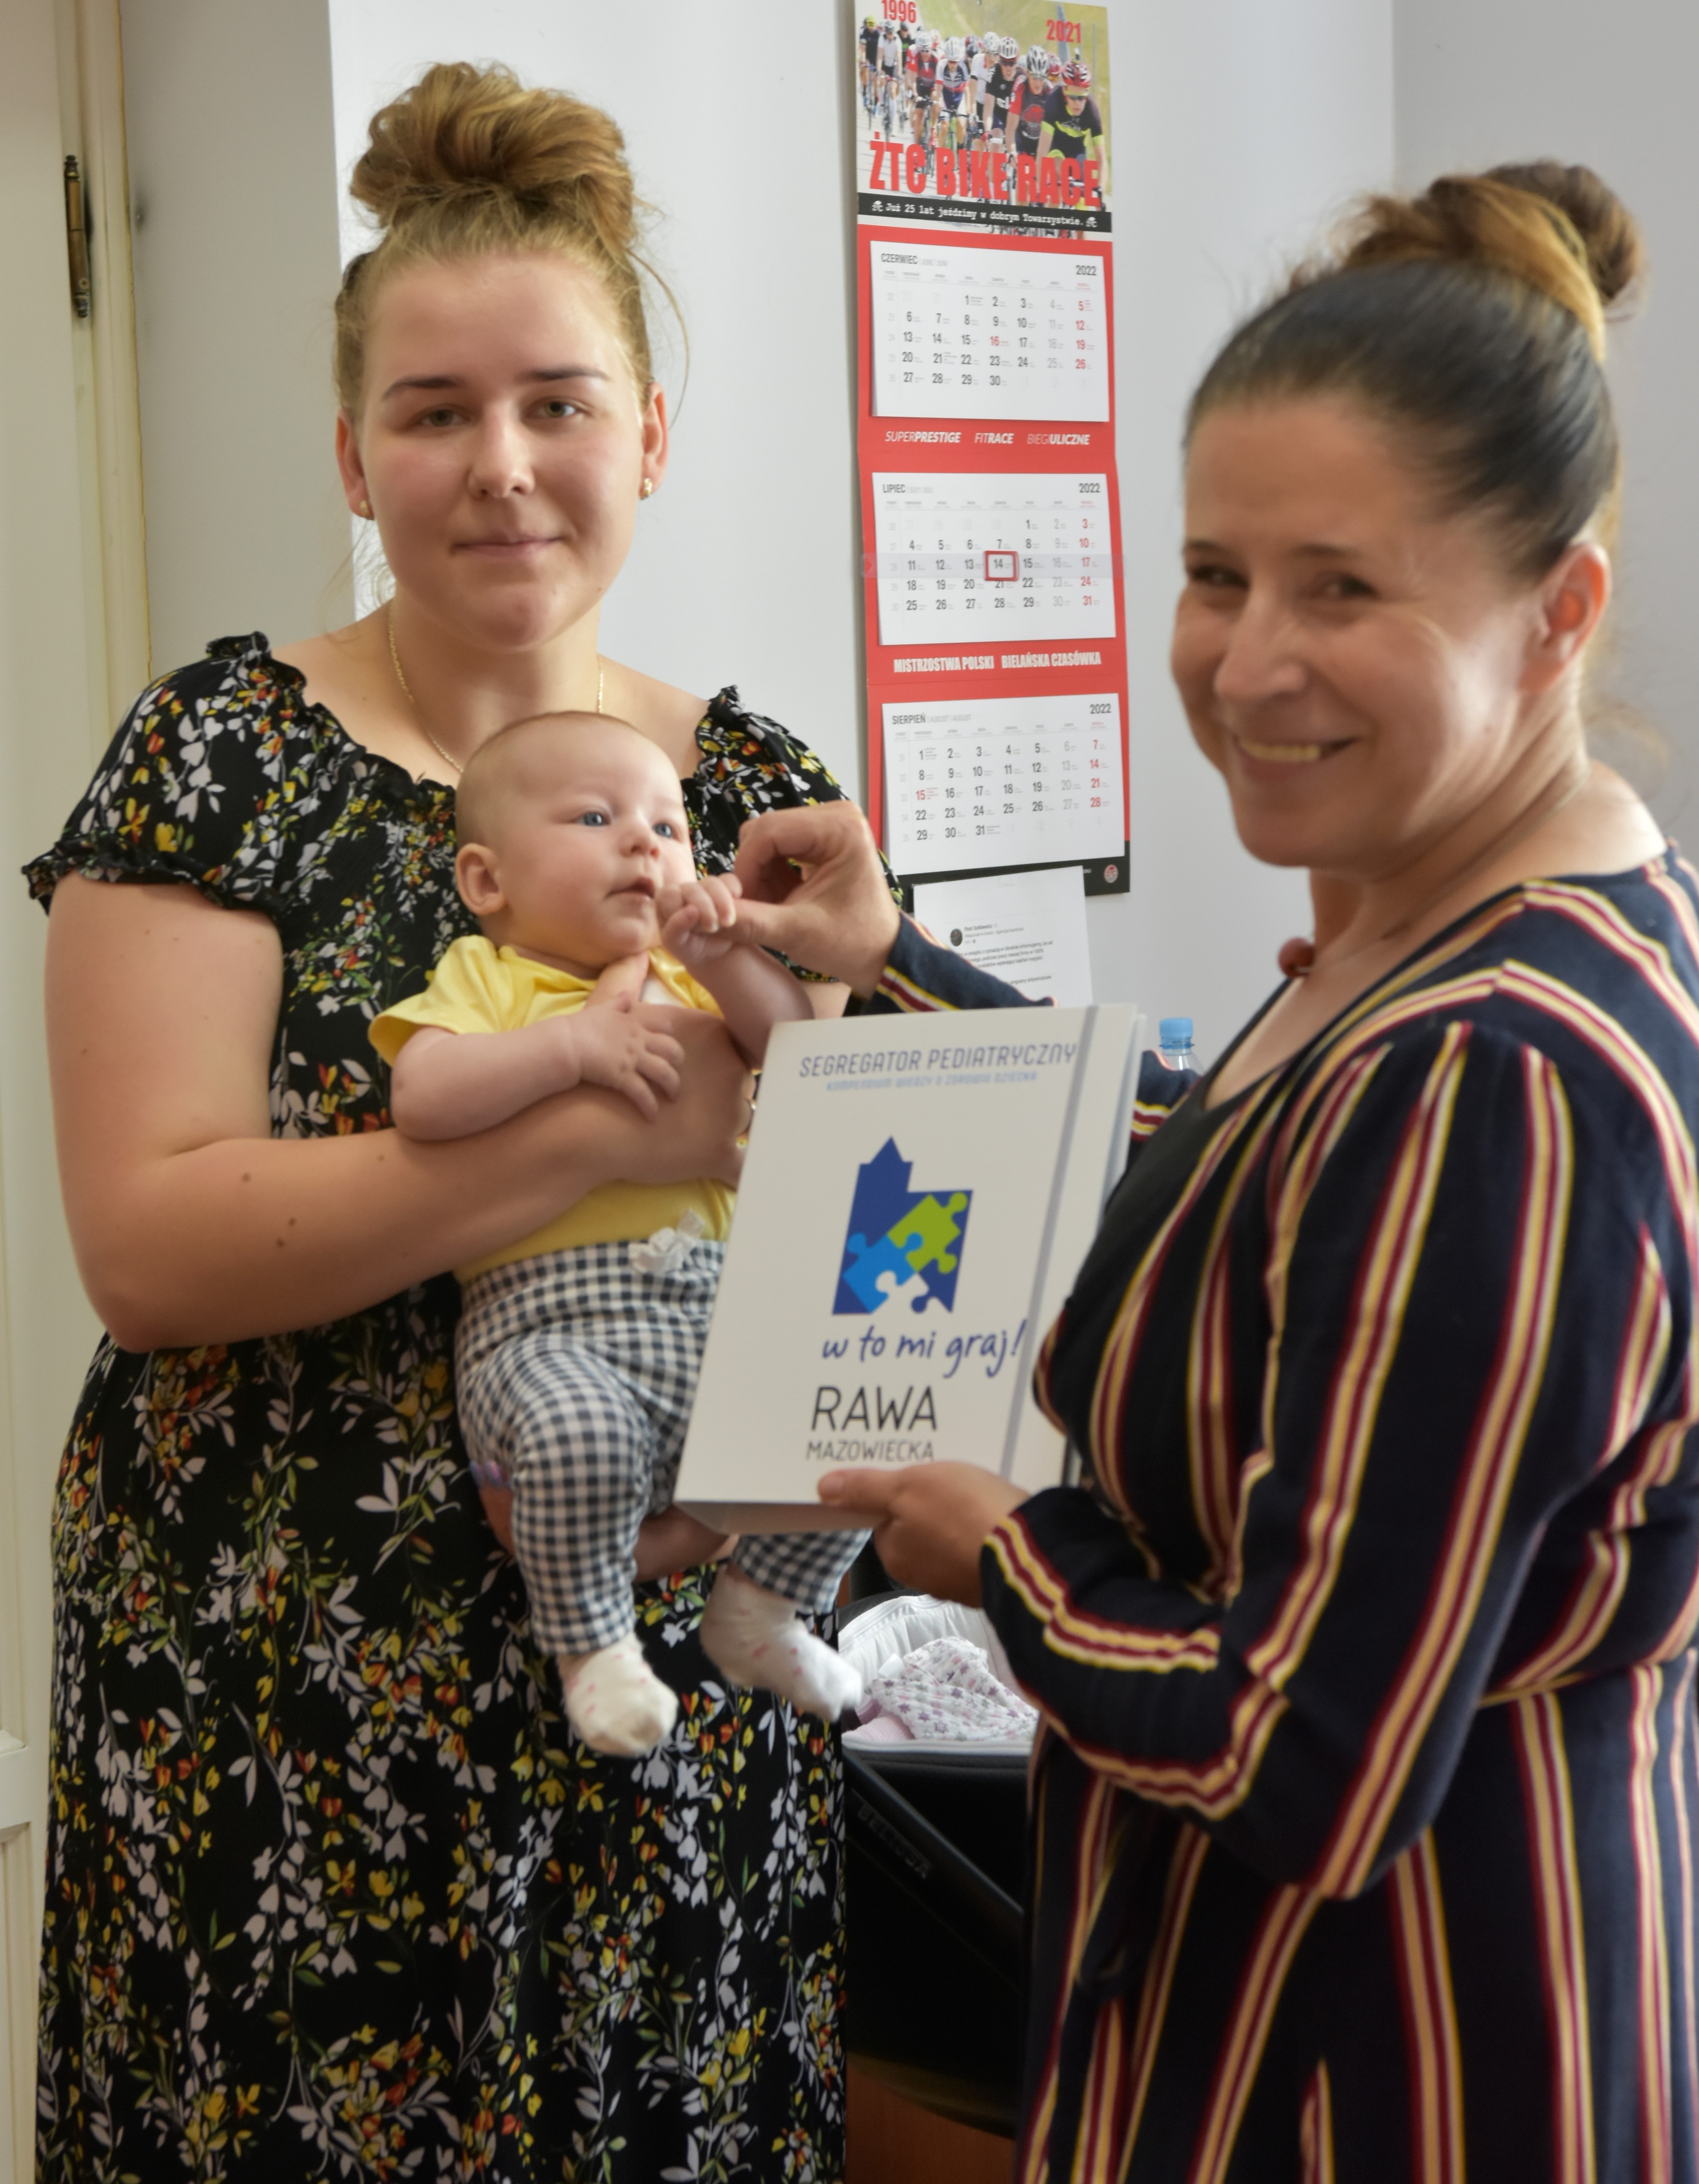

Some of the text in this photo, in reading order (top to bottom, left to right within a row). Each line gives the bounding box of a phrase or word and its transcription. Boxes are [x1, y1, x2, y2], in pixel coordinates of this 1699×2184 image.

[882, 0, 916, 23] 1996
[1046, 19, 1081, 43] 2021
[870, 131, 1101, 207] ŻTC BIKE RACE
[886, 203, 901, 212] Już
[905, 204, 915, 213] 25
[919, 205, 934, 214] lat
[990, 211, 1020, 222] dobrym
[1023, 214, 1083, 225] Towarzystwie.
[881, 253, 918, 265] CZERWIEC
[1076, 265, 1097, 276] 2022
[965, 295, 969, 305] 1
[993, 296, 998, 306] 2
[1021, 298, 1026, 308] 3
[1079, 301, 1084, 311] 5
[907, 311, 912, 322] 6
[936, 313, 941, 323] 7
[965, 314, 970, 325] 8
[993, 316, 998, 326] 9
[1017, 318, 1027, 328] 10
[1076, 320, 1084, 330] 12
[903, 332, 912, 342] 13
[933, 333, 942, 343] 14
[962, 335, 970, 345] 15
[990, 336, 999, 346] 16
[1019, 337, 1027, 347] 17
[1076, 340, 1085, 350] 19
[903, 352, 913, 362] 20
[934, 353, 942, 363] 21
[961, 355, 971, 364] 22
[990, 355, 1000, 366] 23
[1018, 357, 1028, 367] 24
[1076, 359, 1086, 369] 26
[904, 372, 913, 382] 27
[933, 373, 943, 384] 28
[962, 374, 972, 384] 29
[990, 376, 1000, 385] 30
[885, 431, 961, 443] SUPERPRESTIGE
[975, 433, 1014, 444] FITRACE
[882, 484, 906, 493] LIPIEC
[1079, 483, 1101, 494] 2022
[1026, 519, 1030, 529] 1
[1082, 518, 1088, 528] 3
[910, 540, 915, 550] 4
[939, 540, 943, 550] 5
[968, 539, 972, 549] 6
[997, 539, 1002, 550] 7
[1026, 539, 1031, 548] 8
[1079, 538, 1089, 548] 10
[908, 560, 915, 570] 11
[936, 559, 945, 570] 12
[965, 559, 974, 569] 13
[994, 559, 1003, 568] 14
[1023, 558, 1033, 568] 15
[1082, 557, 1090, 567] 17
[907, 580, 916, 590] 18
[936, 580, 945, 590] 19
[964, 579, 975, 589] 20
[995, 580, 1005, 589] 21
[1023, 577, 1033, 588] 22
[1081, 576, 1091, 586] 24
[907, 600, 917, 610] 25
[936, 600, 947, 609] 26
[966, 599, 976, 608] 27
[995, 598, 1005, 608] 28
[1024, 597, 1034, 607] 29
[1083, 596, 1091, 605] 31
[894, 650, 1102, 673] MISTRZOSTWA POLSKI BIELAŃSKA CZASÓWKA
[892, 712, 926, 725] SIERPIEŃ
[1090, 703, 1111, 715] 2022
[919, 750, 923, 760] 1
[948, 748, 953, 758] 2
[977, 747, 982, 756] 3
[1006, 745, 1011, 754] 4
[1035, 743, 1040, 753] 5
[1093, 739, 1098, 749] 7
[919, 770, 925, 780] 8
[949, 768, 954, 778] 9
[973, 766, 982, 776] 10
[1005, 764, 1012, 774] 11
[1032, 763, 1041, 772] 12
[1090, 759, 1099, 768] 14
[916, 790, 925, 800] 15
[945, 788, 955, 798] 16
[975, 786, 983, 796] 17
[1004, 784, 1013, 794] 18
[1033, 782, 1042, 792] 19
[1091, 778, 1099, 788] 21
[916, 810, 927, 820] 22
[945, 808, 955, 818] 23
[974, 806, 984, 816] 24
[1003, 804, 1014, 813] 25
[1033, 801, 1043, 811] 26
[1090, 797, 1101, 807] 28
[917, 830, 927, 840] 29
[945, 827, 956, 838] 30
[976, 825, 984, 835] 31
[800, 1043, 1077, 1077] SEGREGATOR PEDIATRYCZNY
[822, 1319, 1028, 1379] w to mi graj!
[810, 1384, 938, 1432] RAWA
[805, 1439, 935, 1462] MAZOWIECKA
